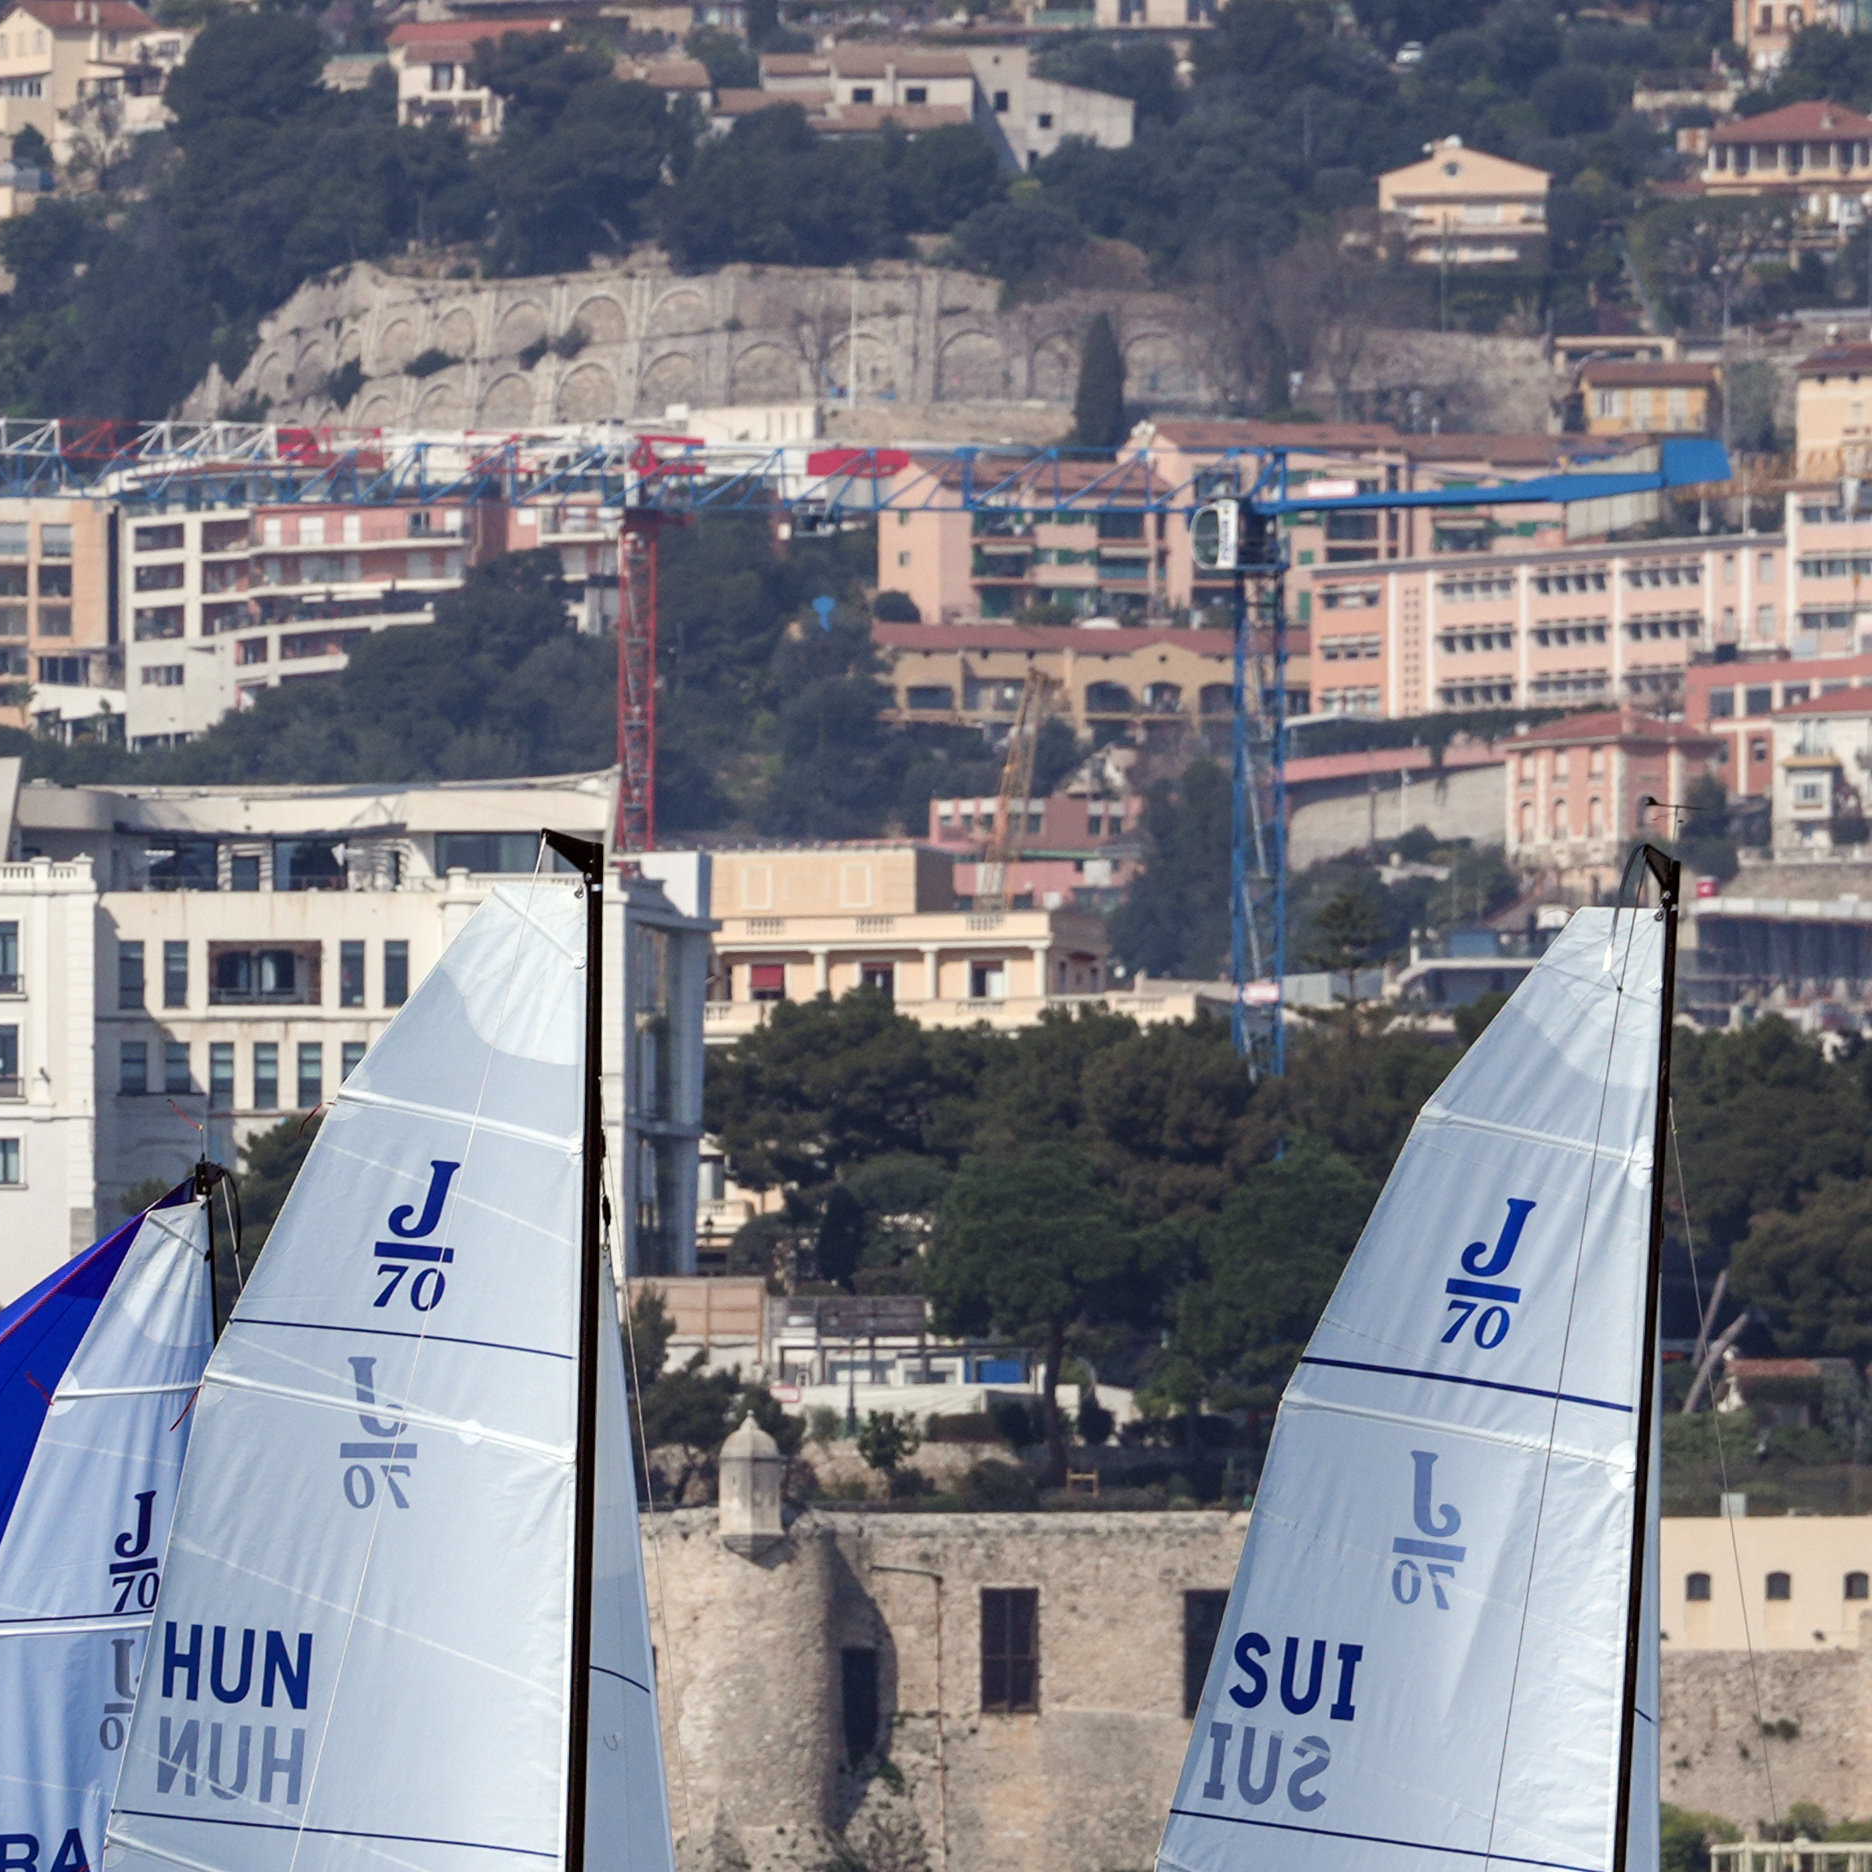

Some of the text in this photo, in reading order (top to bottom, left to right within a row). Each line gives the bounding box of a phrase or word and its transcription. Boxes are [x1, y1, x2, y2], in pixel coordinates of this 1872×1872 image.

[388, 1160, 461, 1239] J
[1460, 1198, 1536, 1278] J
[373, 1262, 447, 1311] 70
[1441, 1298, 1510, 1350] 70
[113, 1491, 157, 1559] J
[110, 1572, 159, 1612] 70
[160, 1620, 313, 1710] HUN
[1229, 1632, 1363, 1721] SUI
